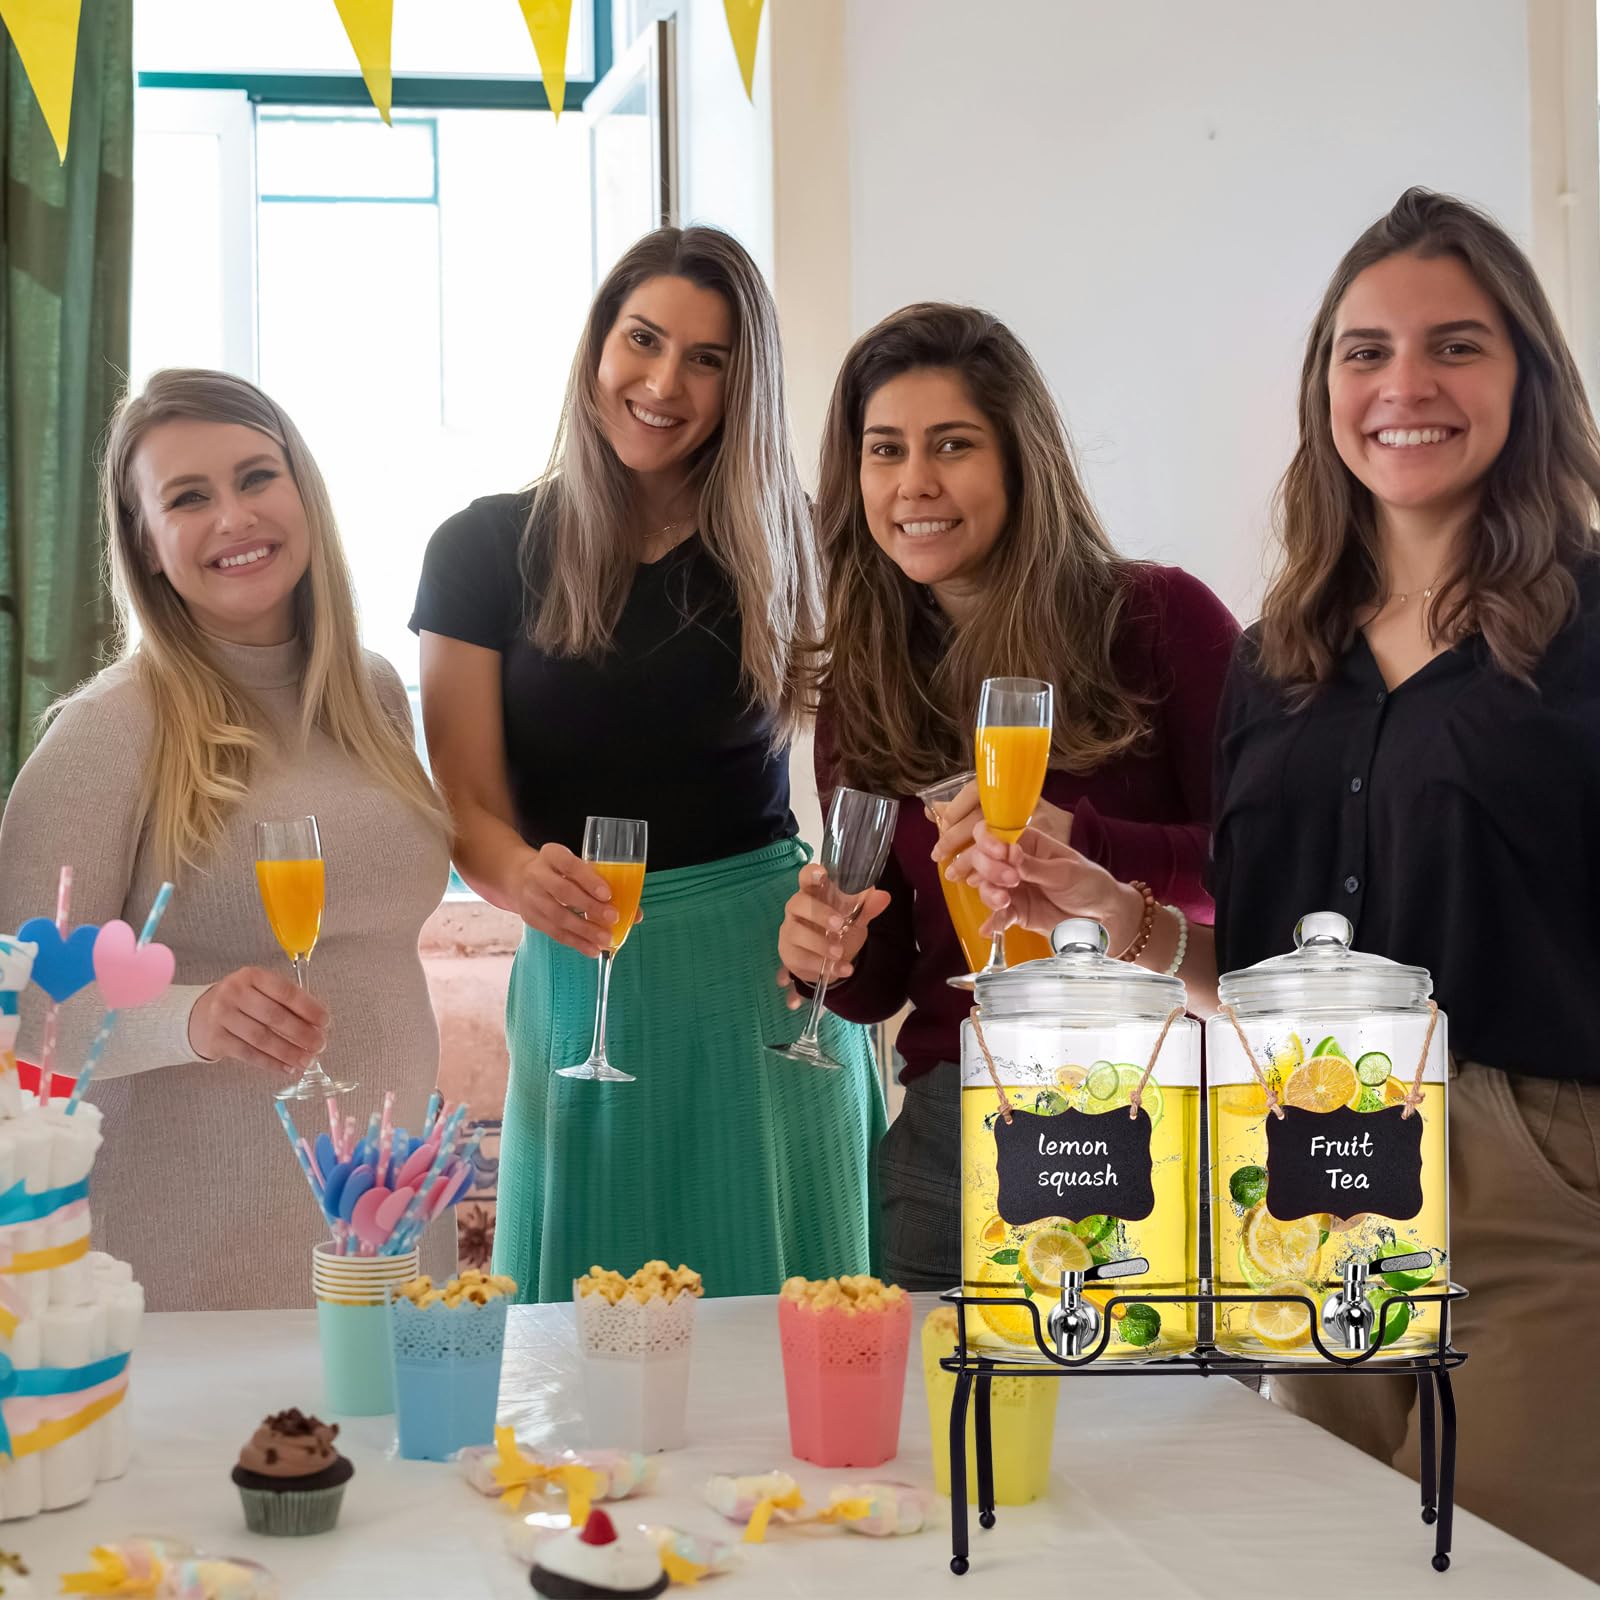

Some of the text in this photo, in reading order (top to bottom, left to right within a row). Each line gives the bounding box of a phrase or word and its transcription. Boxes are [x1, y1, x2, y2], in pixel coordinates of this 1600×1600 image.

[1038, 1132, 1109, 1157] lemon
[1310, 1131, 1374, 1158] Fruit
[1037, 1163, 1119, 1197] squash
[1325, 1168, 1370, 1191] Tea
